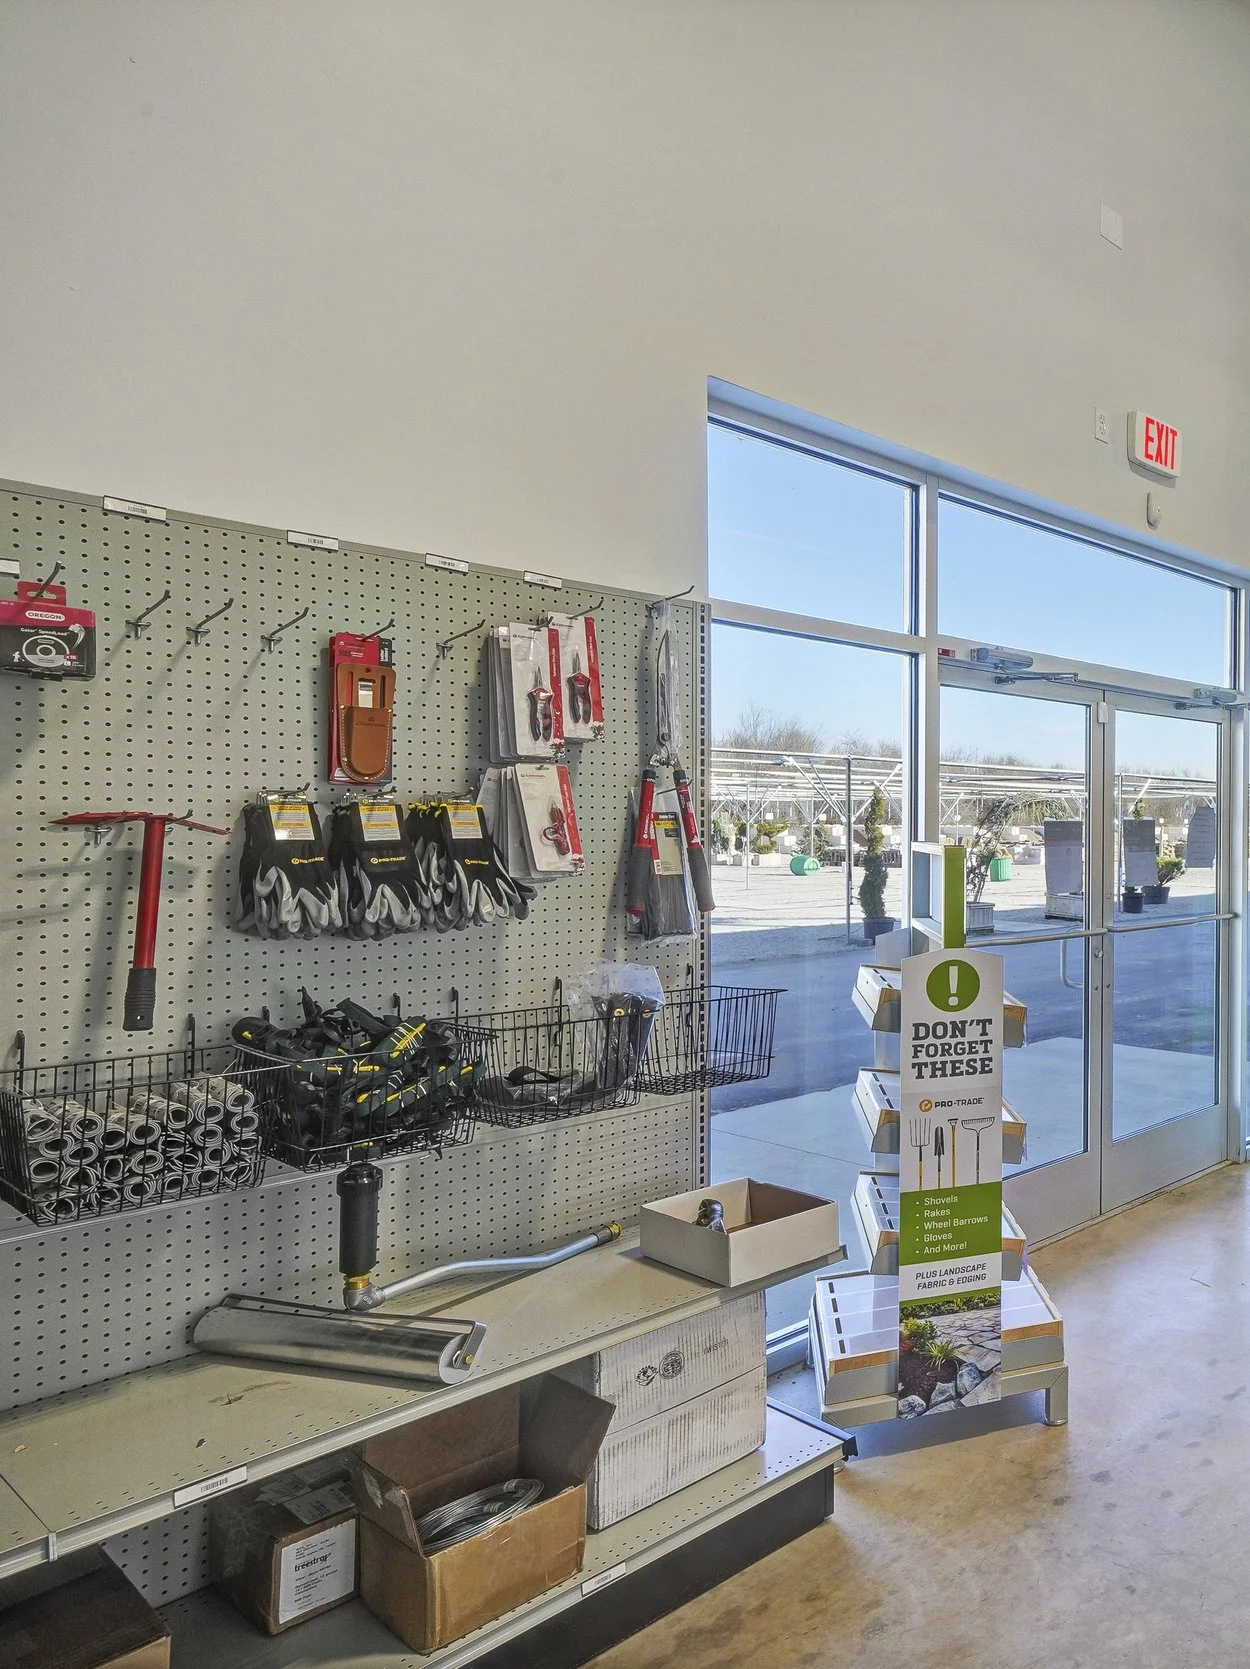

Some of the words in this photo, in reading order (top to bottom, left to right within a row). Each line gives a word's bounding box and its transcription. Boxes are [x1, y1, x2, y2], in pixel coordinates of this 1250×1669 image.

[1145, 416, 1178, 470] EXIT
[28, 612, 62, 620] OREGON
[911, 1018, 993, 1041] DON'T
[911, 1039, 993, 1059] FORGET
[911, 1056, 993, 1080] THESE
[934, 1097, 984, 1108] PRO-TRADE
[924, 1195, 958, 1206] Shovels
[924, 1208, 951, 1218] Rakes
[923, 1219, 951, 1230] Wheel
[953, 1215, 989, 1227] Barrows
[923, 1232, 953, 1243] Gloves
[923, 1245, 941, 1255] And
[943, 1241, 967, 1252] More!
[915, 1270, 937, 1280] PLUS
[939, 1262, 987, 1277] LANDSCAPE
[916, 1279, 947, 1290] FABRIC
[948, 1278, 955, 1286] &
[956, 1273, 987, 1285] EDGING
[294, 1552, 332, 1572] treestrap
